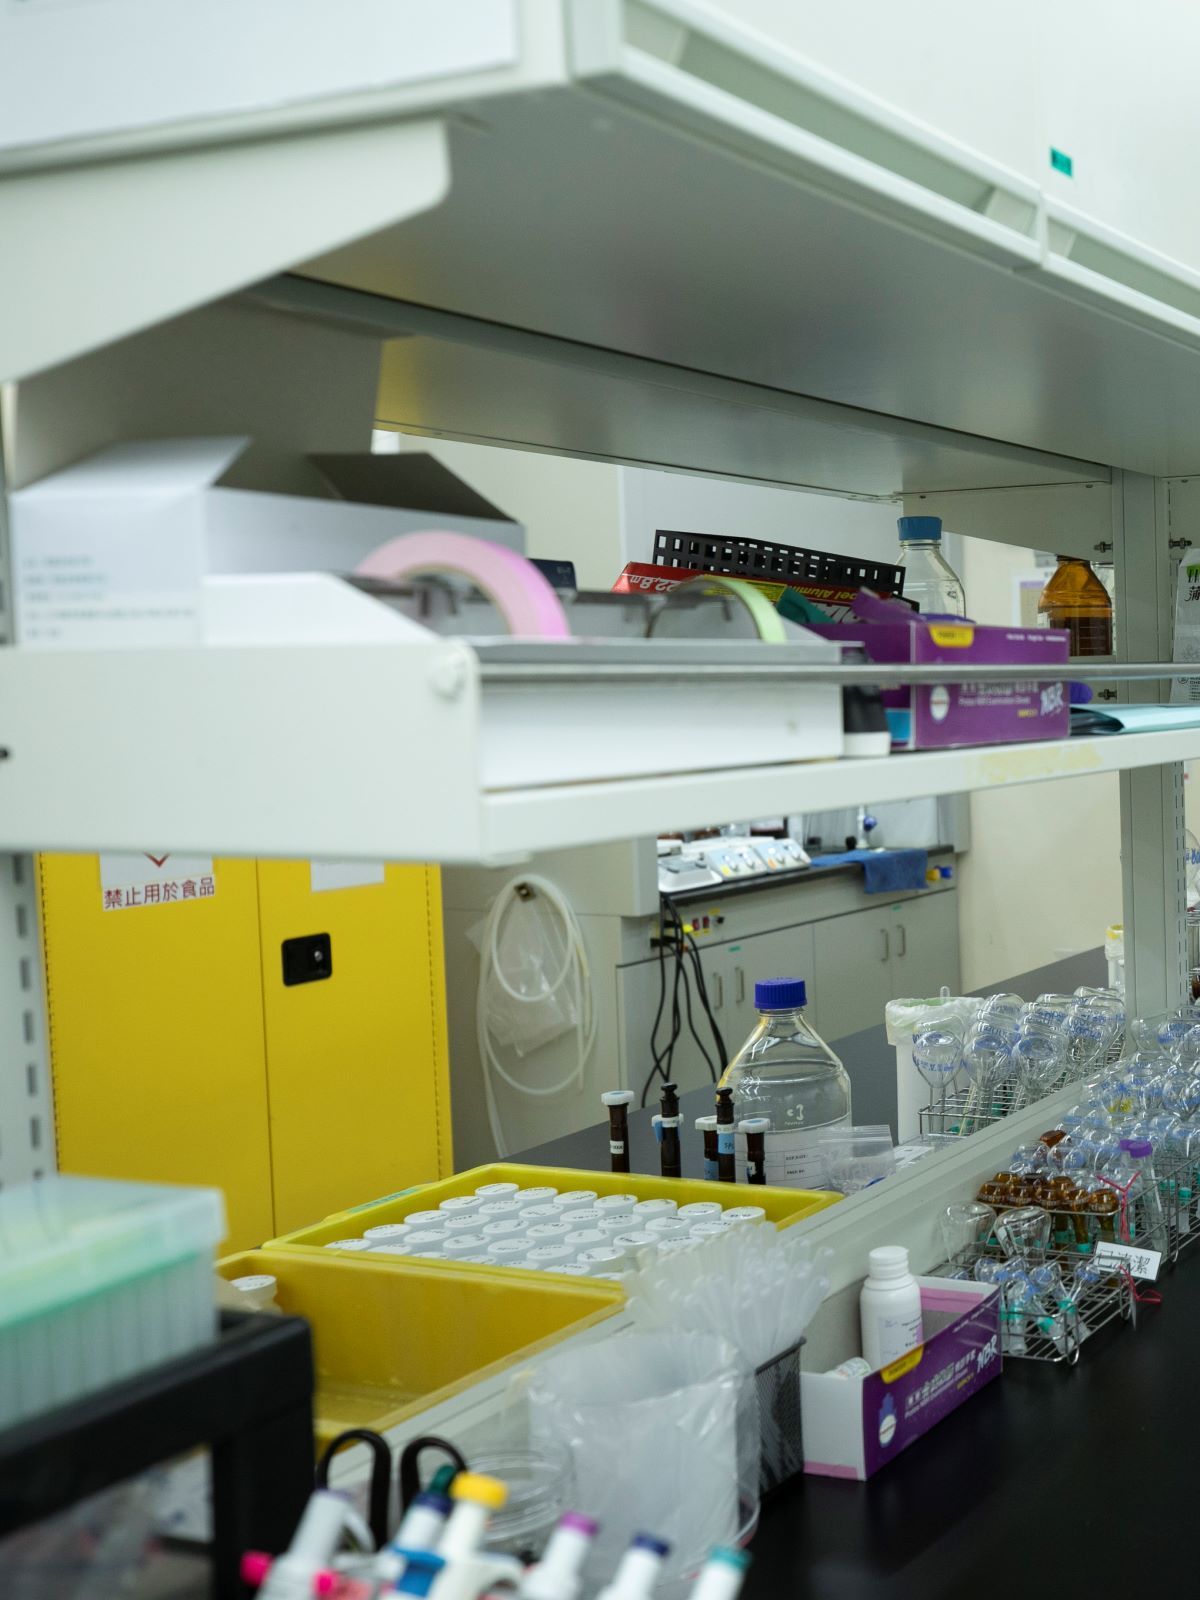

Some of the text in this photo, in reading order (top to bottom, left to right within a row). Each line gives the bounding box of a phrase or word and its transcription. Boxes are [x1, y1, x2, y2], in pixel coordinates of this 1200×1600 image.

[104, 877, 214, 909] 禁止用於食品
